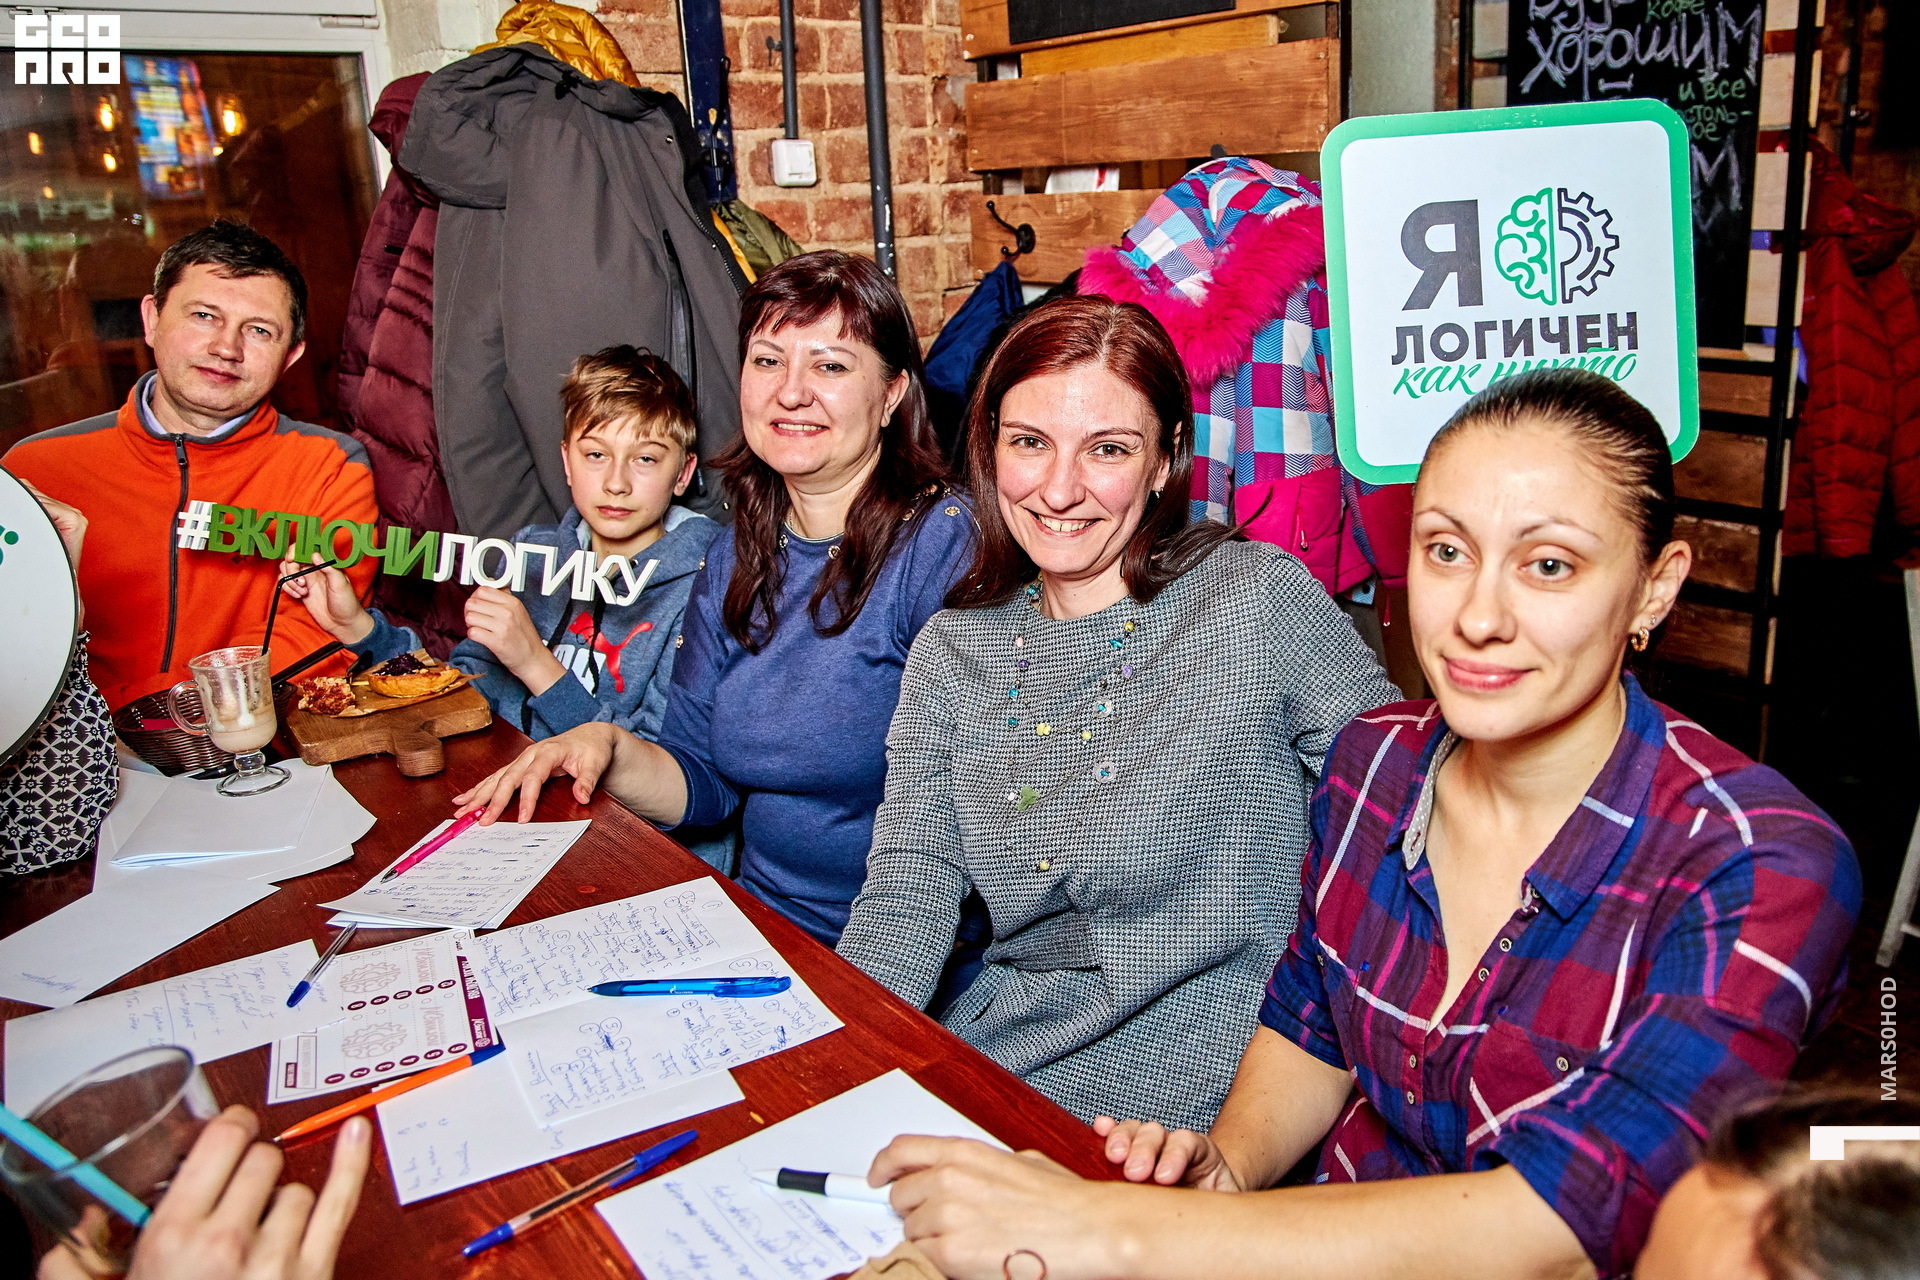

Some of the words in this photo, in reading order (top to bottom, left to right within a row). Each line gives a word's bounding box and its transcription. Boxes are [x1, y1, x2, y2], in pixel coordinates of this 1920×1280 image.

[1401, 199, 1483, 311] Я
[1391, 311, 1638, 365] ЛОГИЧЕН
[1393, 362, 1482, 399] как
[177, 500, 660, 606] #ВКЛЮЧИЛОГИКУ
